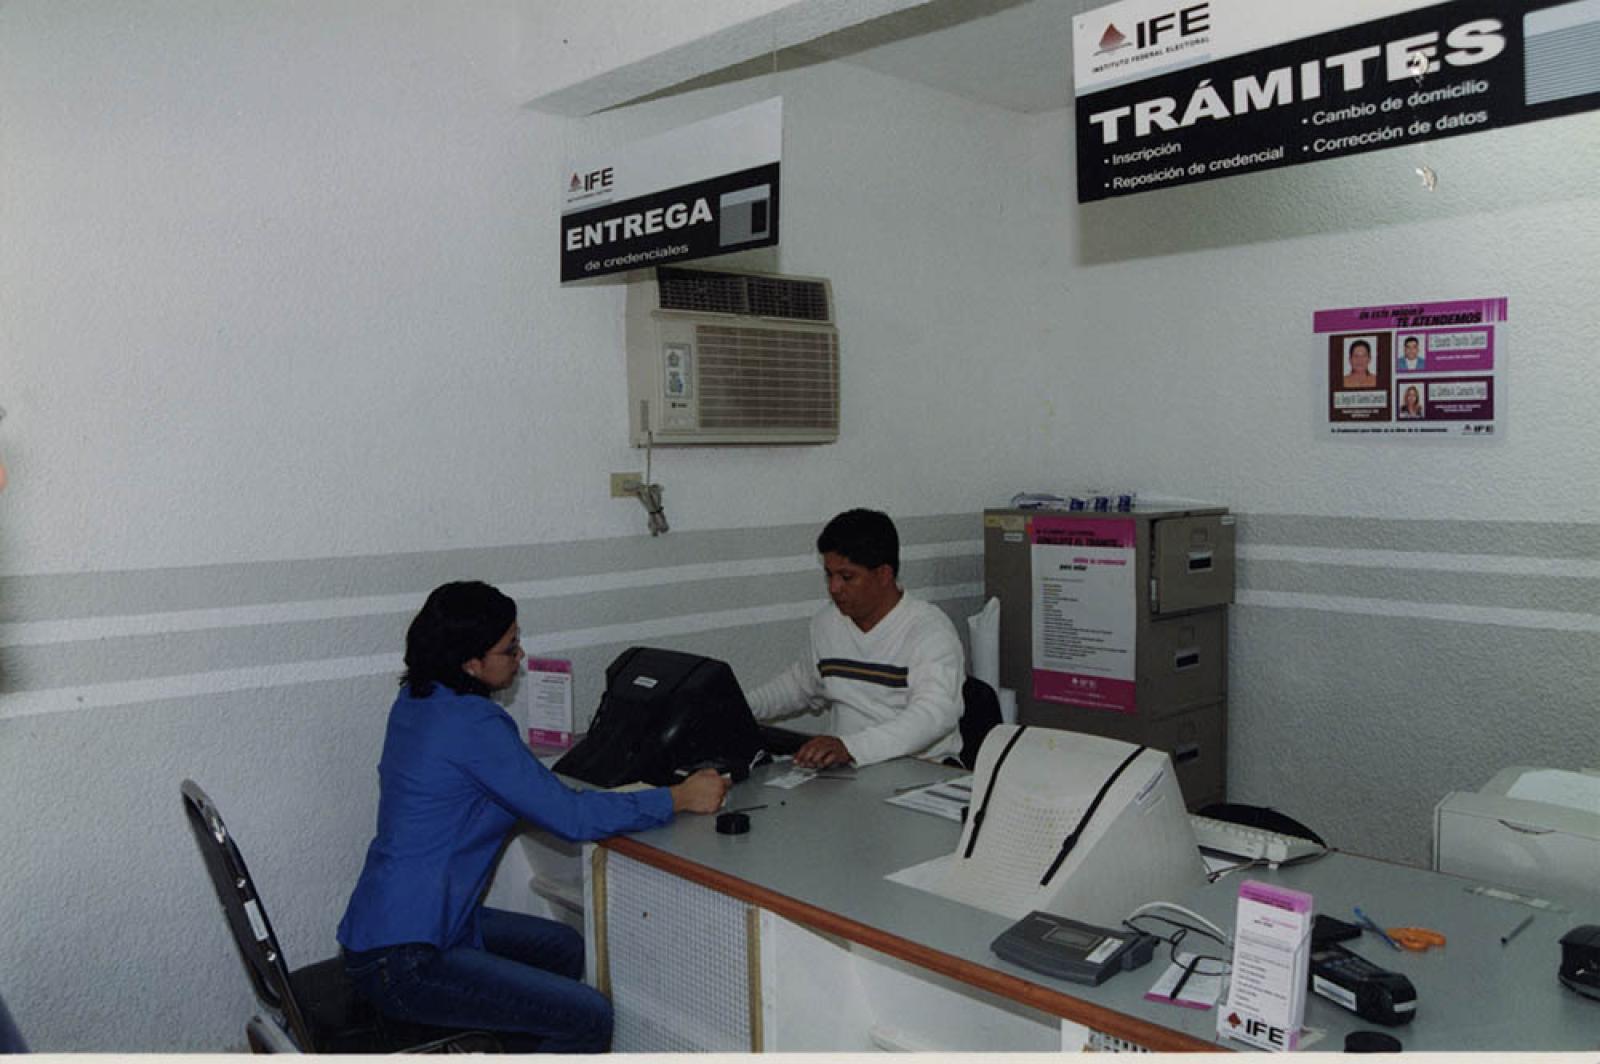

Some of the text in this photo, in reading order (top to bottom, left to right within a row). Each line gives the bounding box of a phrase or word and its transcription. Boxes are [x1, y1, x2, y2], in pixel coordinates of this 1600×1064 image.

[1137, 3, 1210, 49] IFE
[1131, 50, 1163, 62] FEDERAL
[1165, 37, 1209, 53] ELECTORAL
[1089, 18, 1507, 144] TRÁMITES
[1312, 79, 1489, 125] Cambio de domicilio
[1313, 110, 1488, 153] Corrección de datos
[1112, 142, 1182, 166] Inscripción
[1113, 146, 1284, 189] Reposición de credencial
[584, 167, 614, 192] IFE
[566, 197, 713, 252] ENTREGA
[584, 243, 689, 272] de credenciales
[1245, 1018, 1286, 1046] IFE
